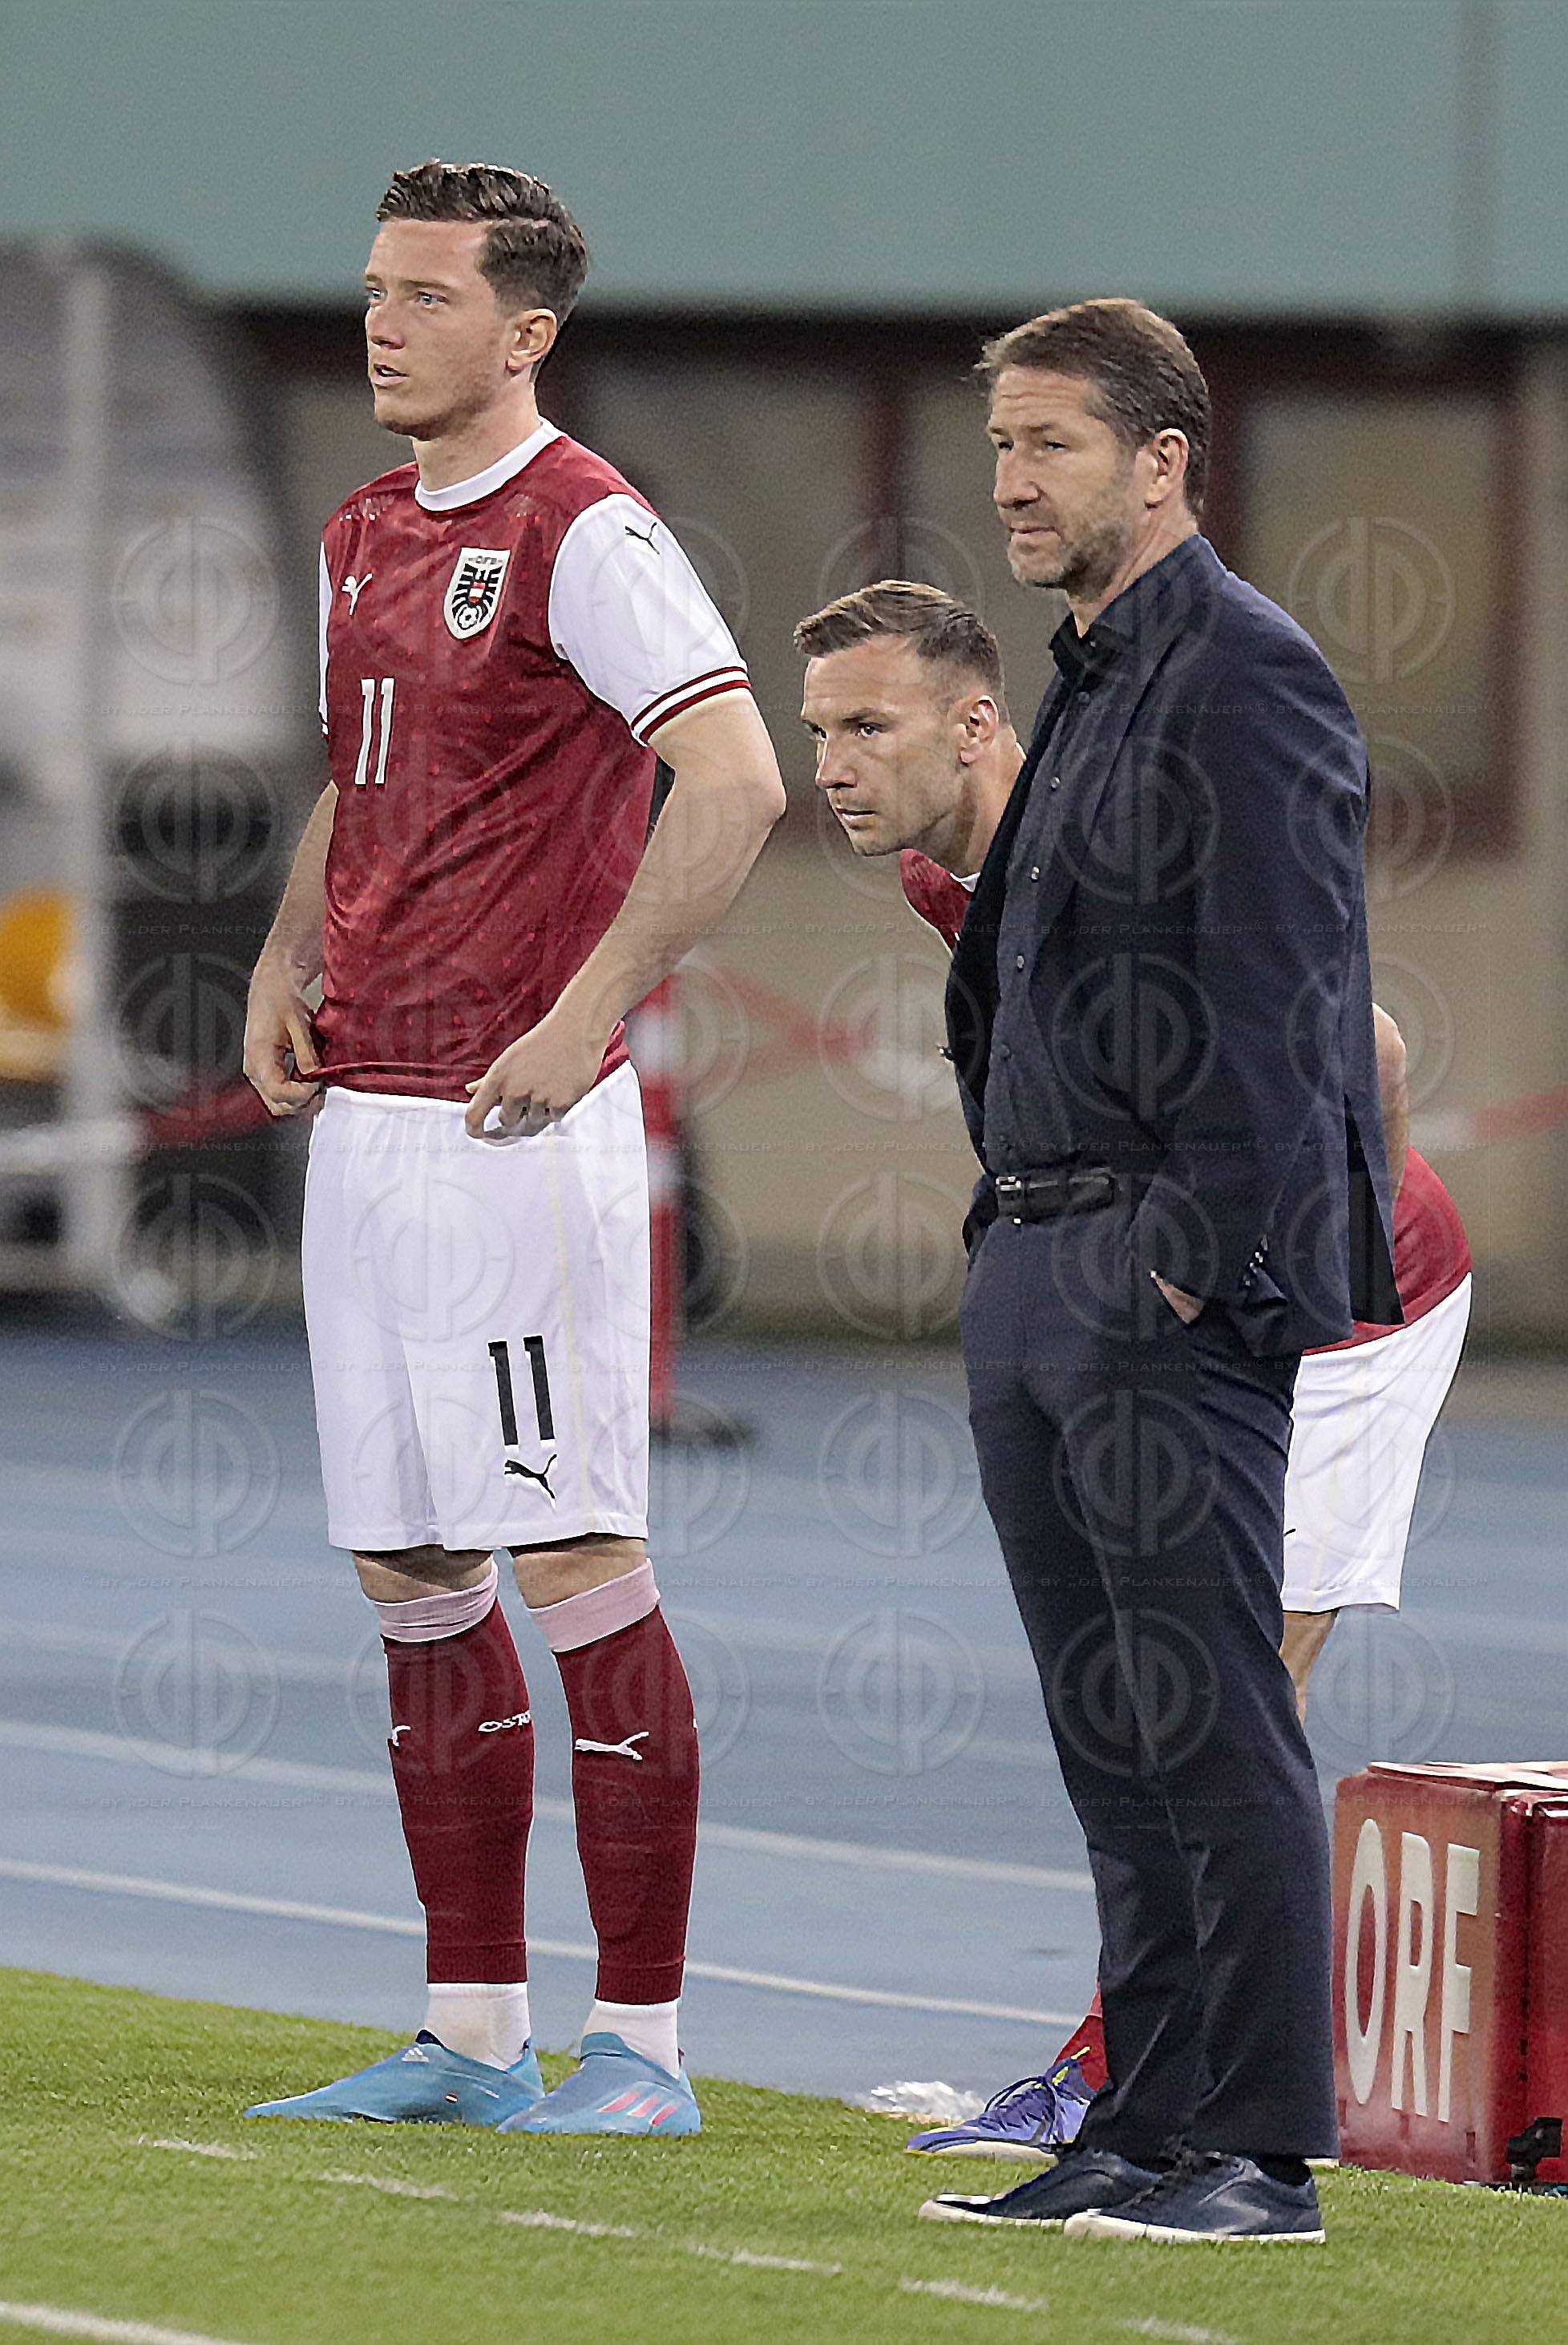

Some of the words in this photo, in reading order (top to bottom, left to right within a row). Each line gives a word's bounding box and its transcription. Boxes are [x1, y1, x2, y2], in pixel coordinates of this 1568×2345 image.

[354, 677, 395, 785] 11
[487, 1335, 556, 1445] 11
[1345, 1818, 1480, 2123] ORF
